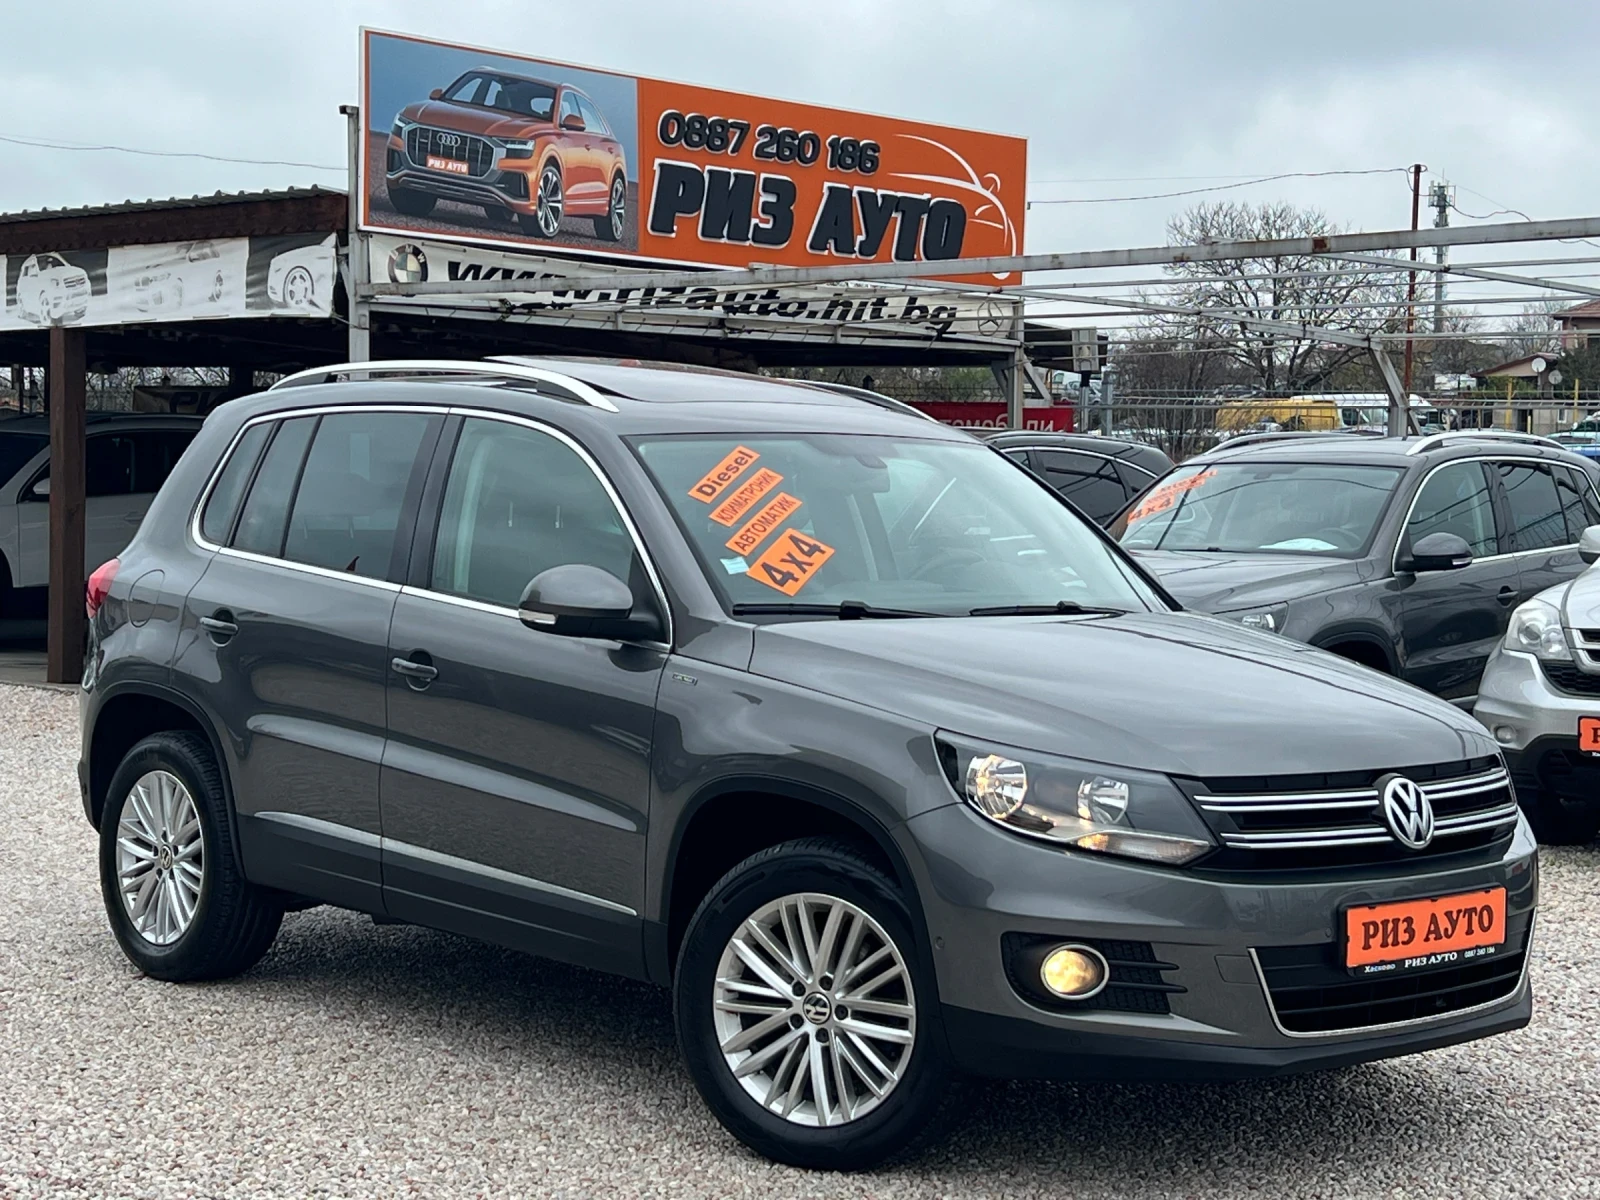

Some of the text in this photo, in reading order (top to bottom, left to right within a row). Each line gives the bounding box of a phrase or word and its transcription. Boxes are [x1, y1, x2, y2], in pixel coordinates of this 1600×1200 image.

[427, 158, 468, 173] РИЗ АУТО
[658, 109, 881, 174] 0887 260 186
[647, 158, 967, 262] РИЗ АУТО
[696, 450, 754, 497] Diesel
[716, 471, 776, 523] КЛИМАТРОНИК
[734, 496, 797, 551] АВТОМАТИК
[1361, 904, 1494, 951] РИЗ АУТО
[1404, 954, 1426, 968] РИЗ
[1427, 951, 1458, 965] АУТО
